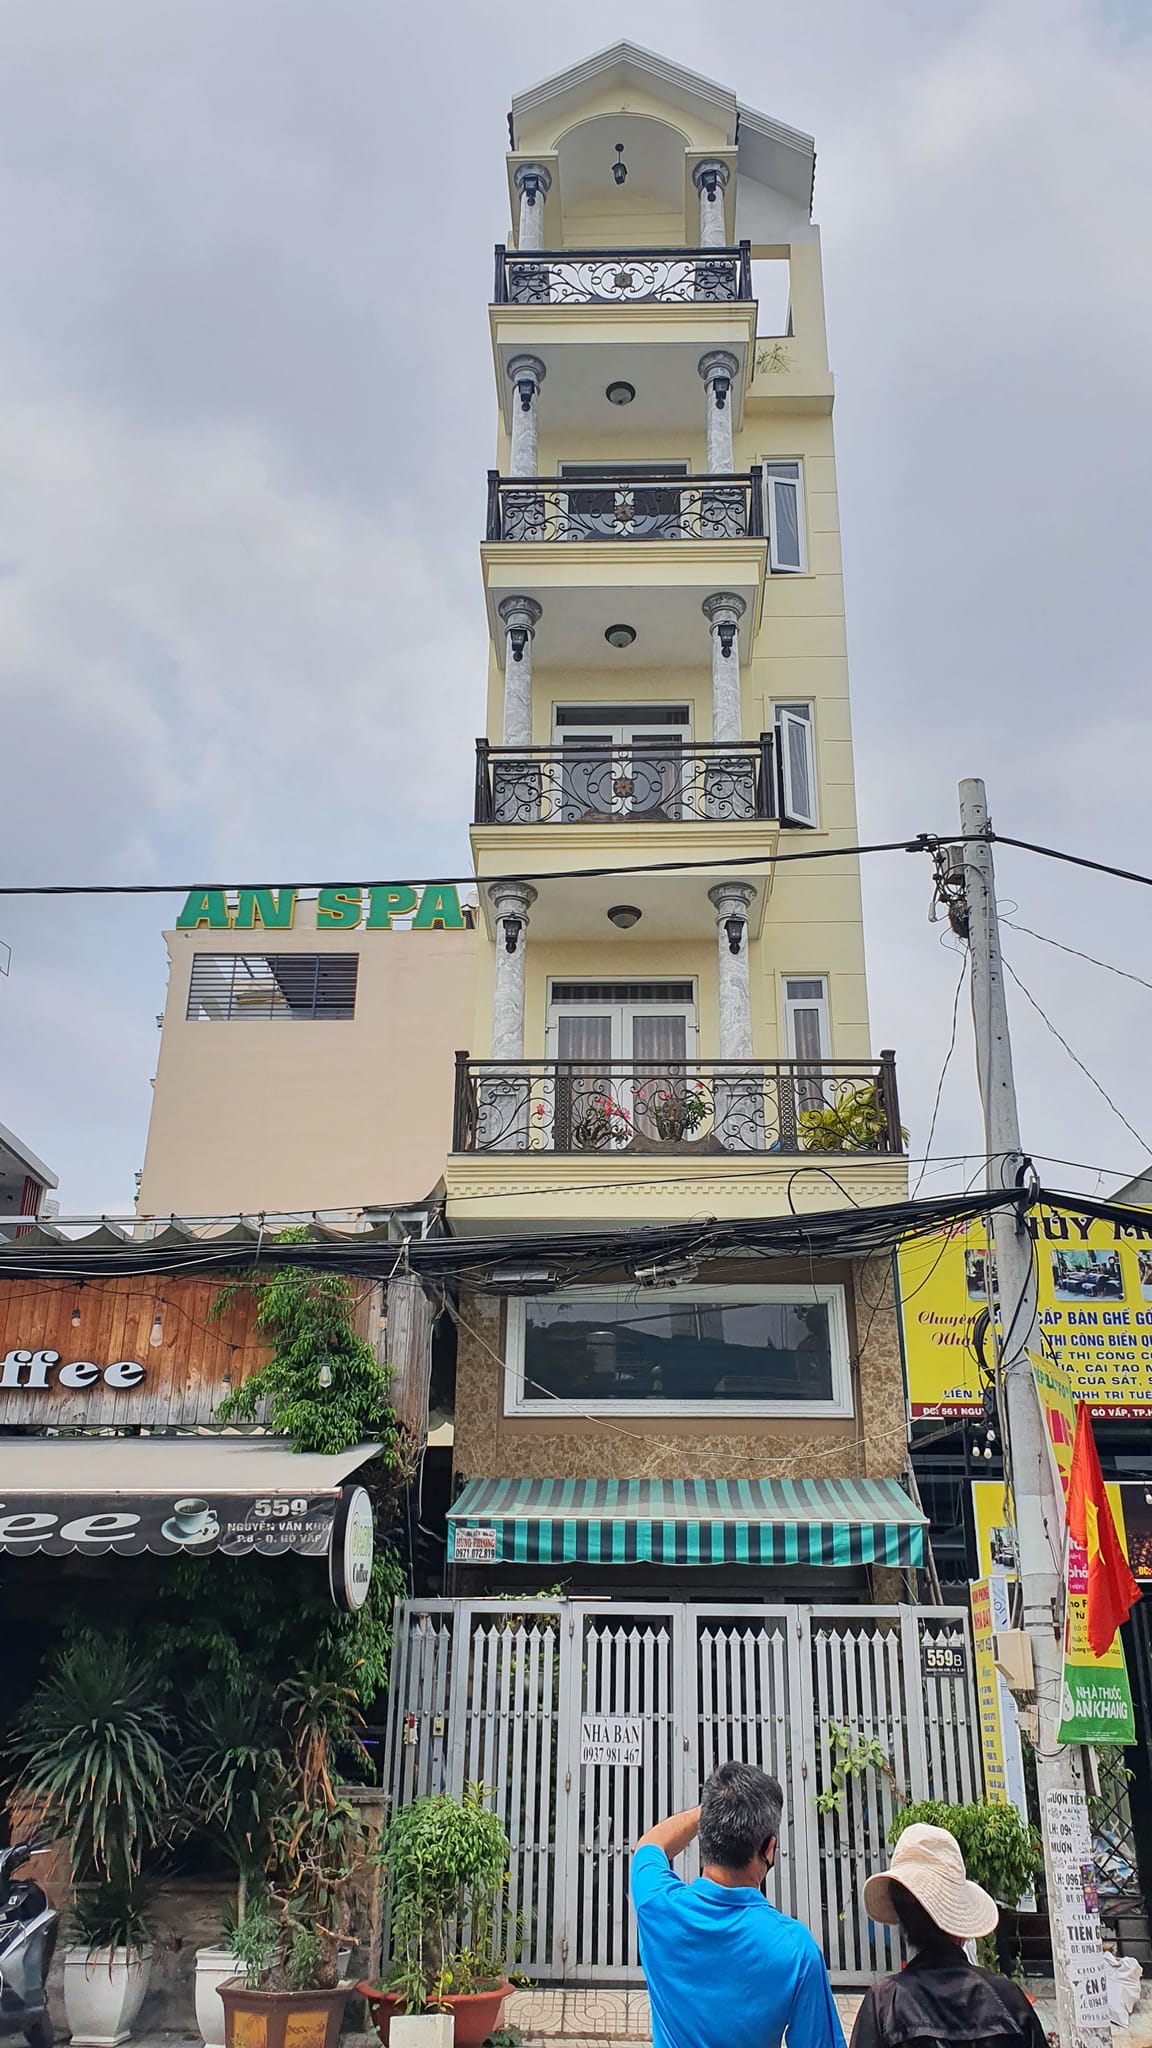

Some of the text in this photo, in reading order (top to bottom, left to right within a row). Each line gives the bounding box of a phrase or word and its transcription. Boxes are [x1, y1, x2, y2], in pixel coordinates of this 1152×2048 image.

[176, 886, 466, 930] AN SPA
[918, 1311, 977, 1327] Chuyên
[1068, 1308, 1098, 1325] BÀN
[1102, 1307, 1131, 1325] GHẾ
[1048, 1335, 1067, 1346] THI
[1071, 1332, 1105, 1346] CÔNG
[1069, 1351, 1091, 1360] THI
[1096, 1349, 1136, 1360] CÔNG
[1072, 1390, 1099, 1399] NHH
[942, 1407, 958, 1416] 561
[254, 1499, 308, 1517] 559
[0, 1503, 142, 1543] ee
[1076, 1684, 1098, 1699] NHÀ
[1076, 1700, 1128, 1719] AN KHANG
[583, 1719, 640, 1743] NHÀ BÁN
[584, 1746, 639, 1763] 0937 981 467
